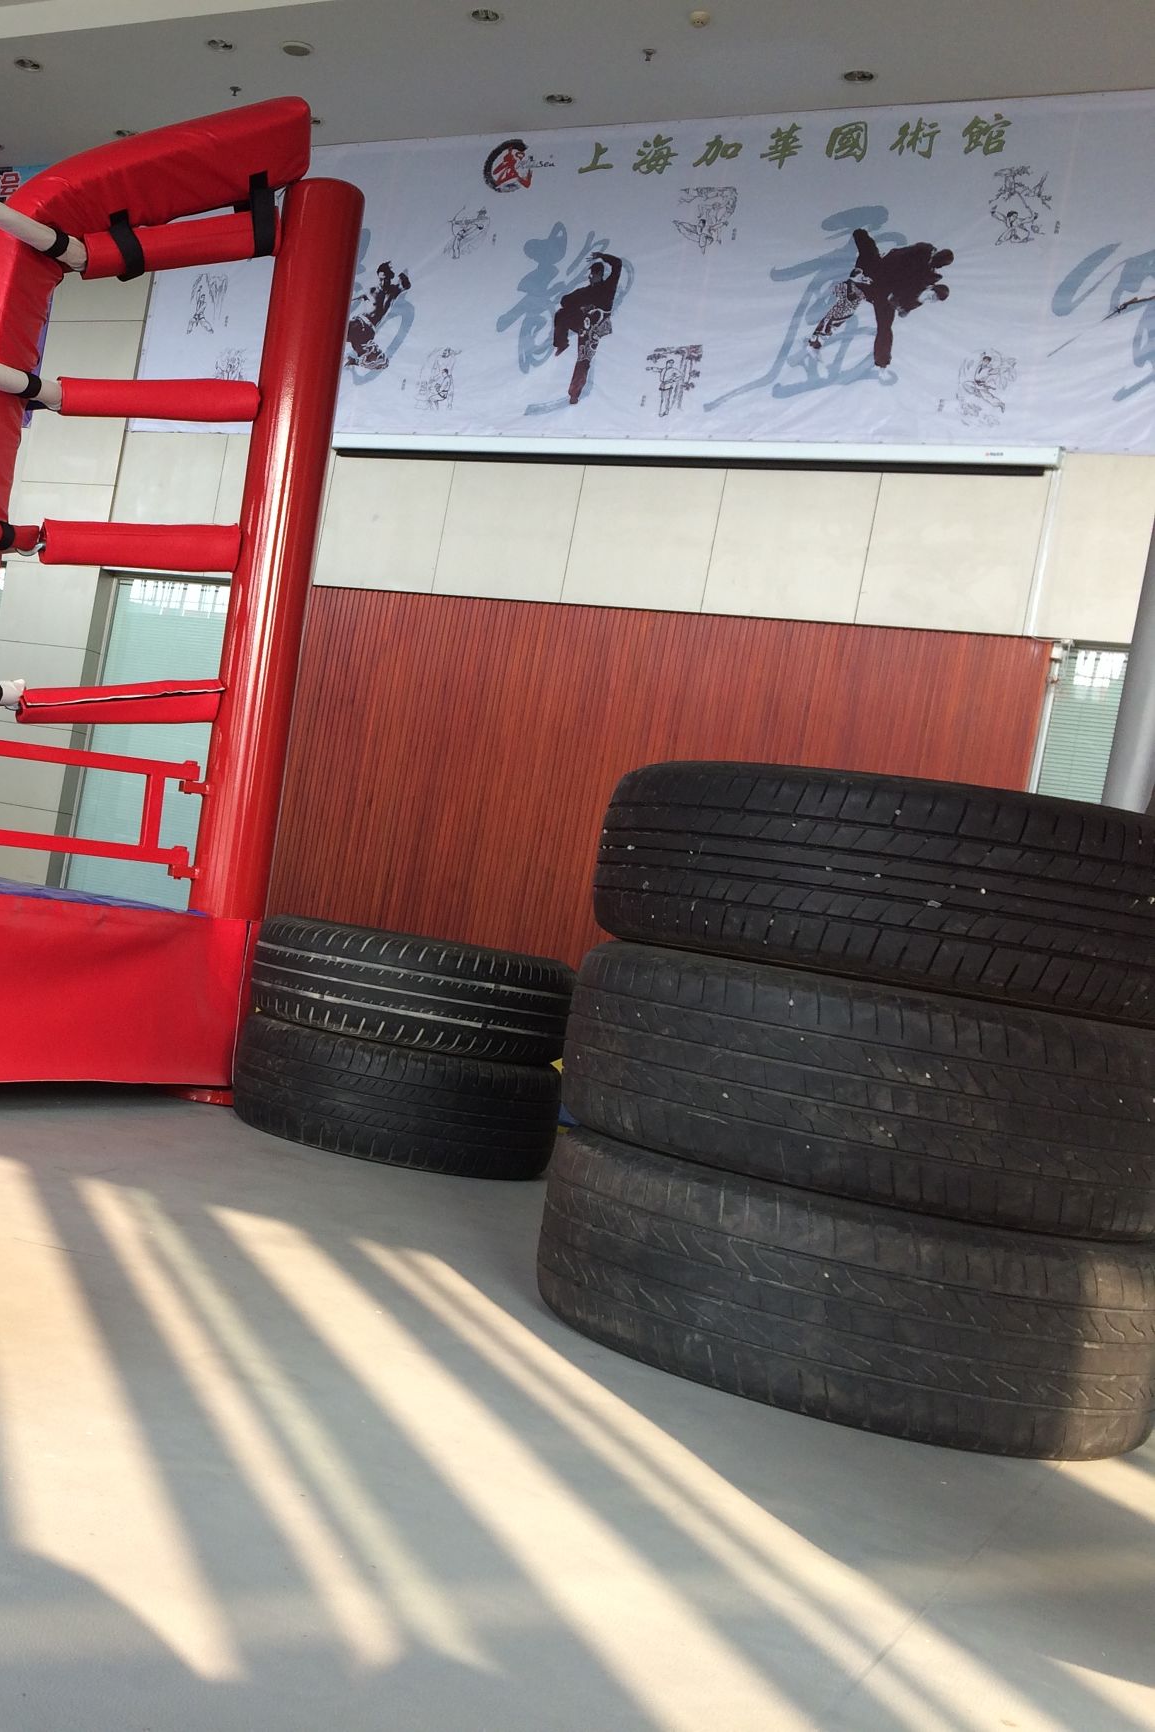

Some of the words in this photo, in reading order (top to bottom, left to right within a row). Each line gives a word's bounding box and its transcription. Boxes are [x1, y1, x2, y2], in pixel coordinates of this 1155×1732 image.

[578, 113, 1013, 175] 上海加華國術館
